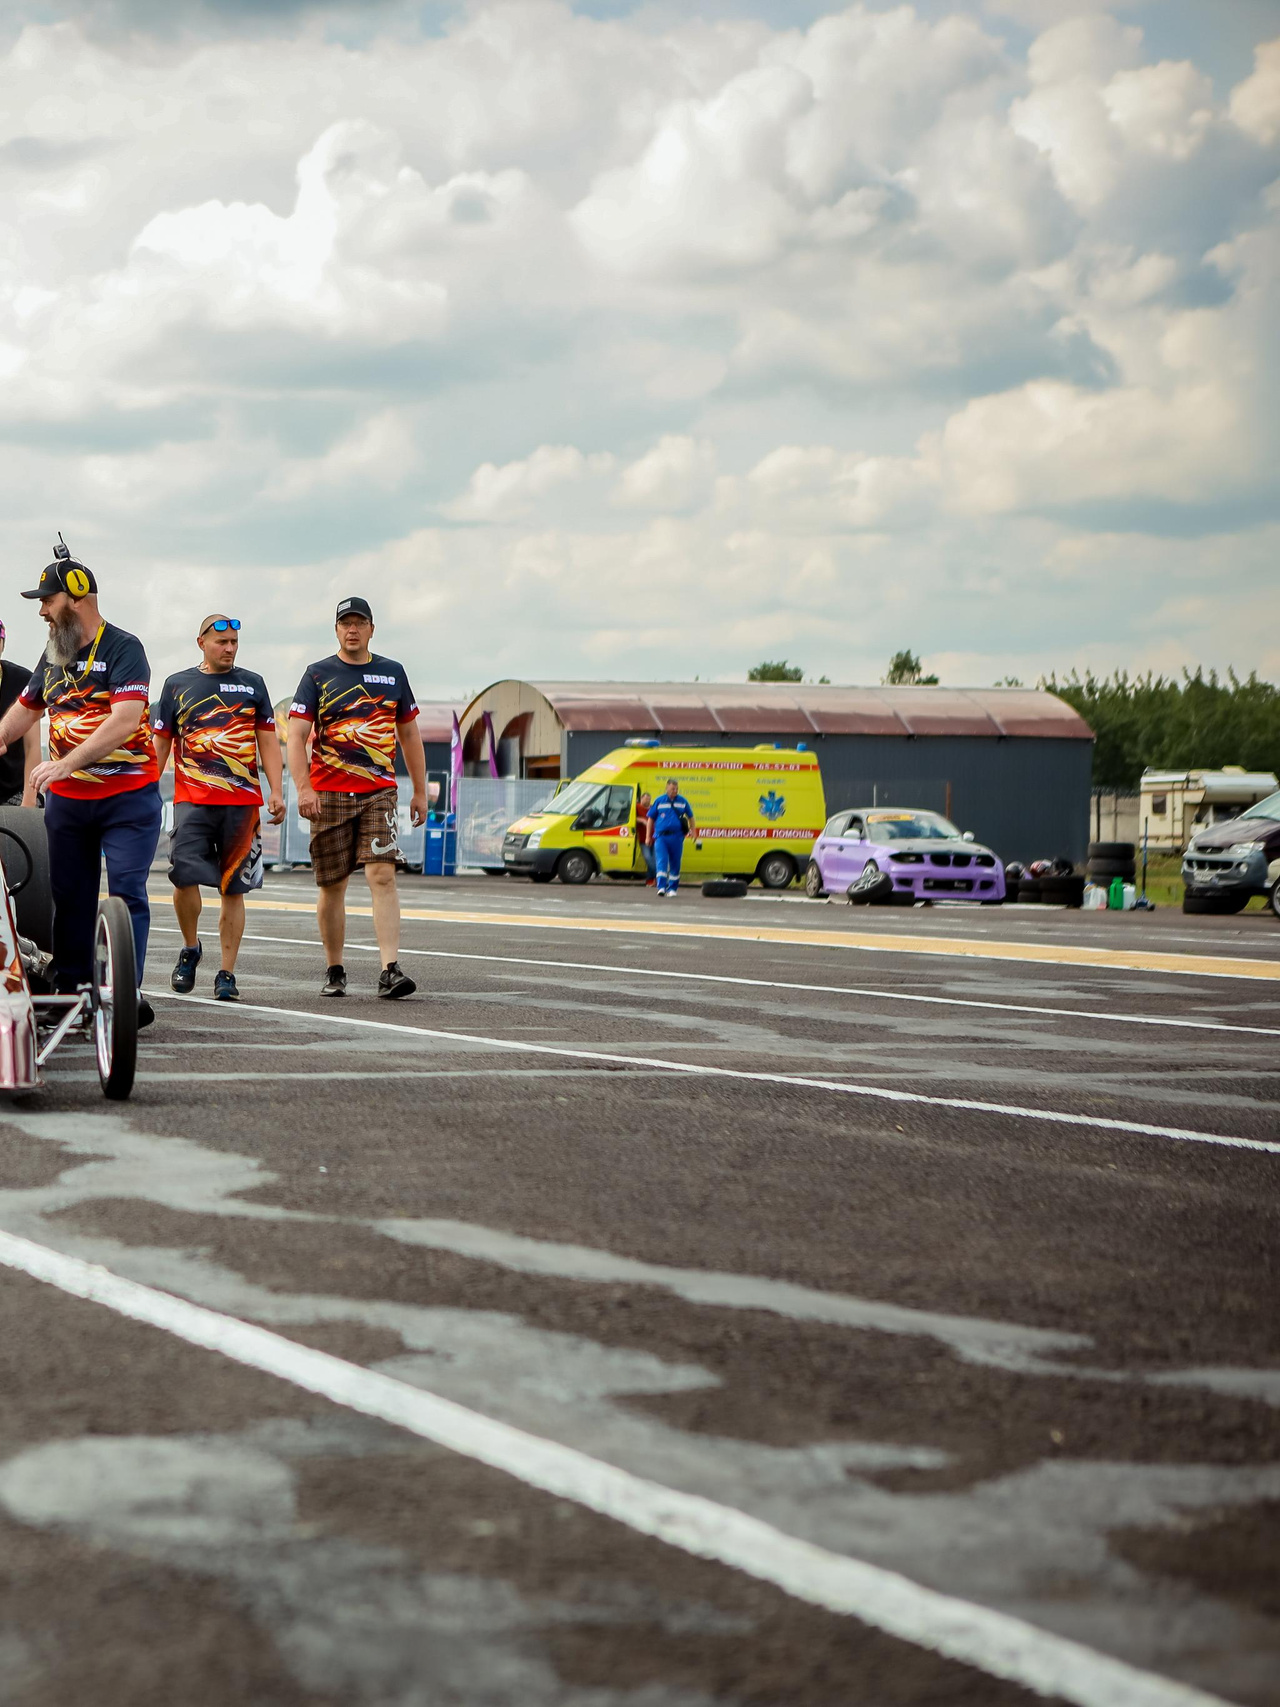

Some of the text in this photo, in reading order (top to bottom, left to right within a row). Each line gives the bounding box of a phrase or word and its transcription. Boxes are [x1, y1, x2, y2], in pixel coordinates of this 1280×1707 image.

[363, 674, 396, 686] RDRC
[219, 683, 255, 695] RDRC
[698, 828, 814, 839] МЕДИЦИНСКАЯ ПОМОЩЬ
